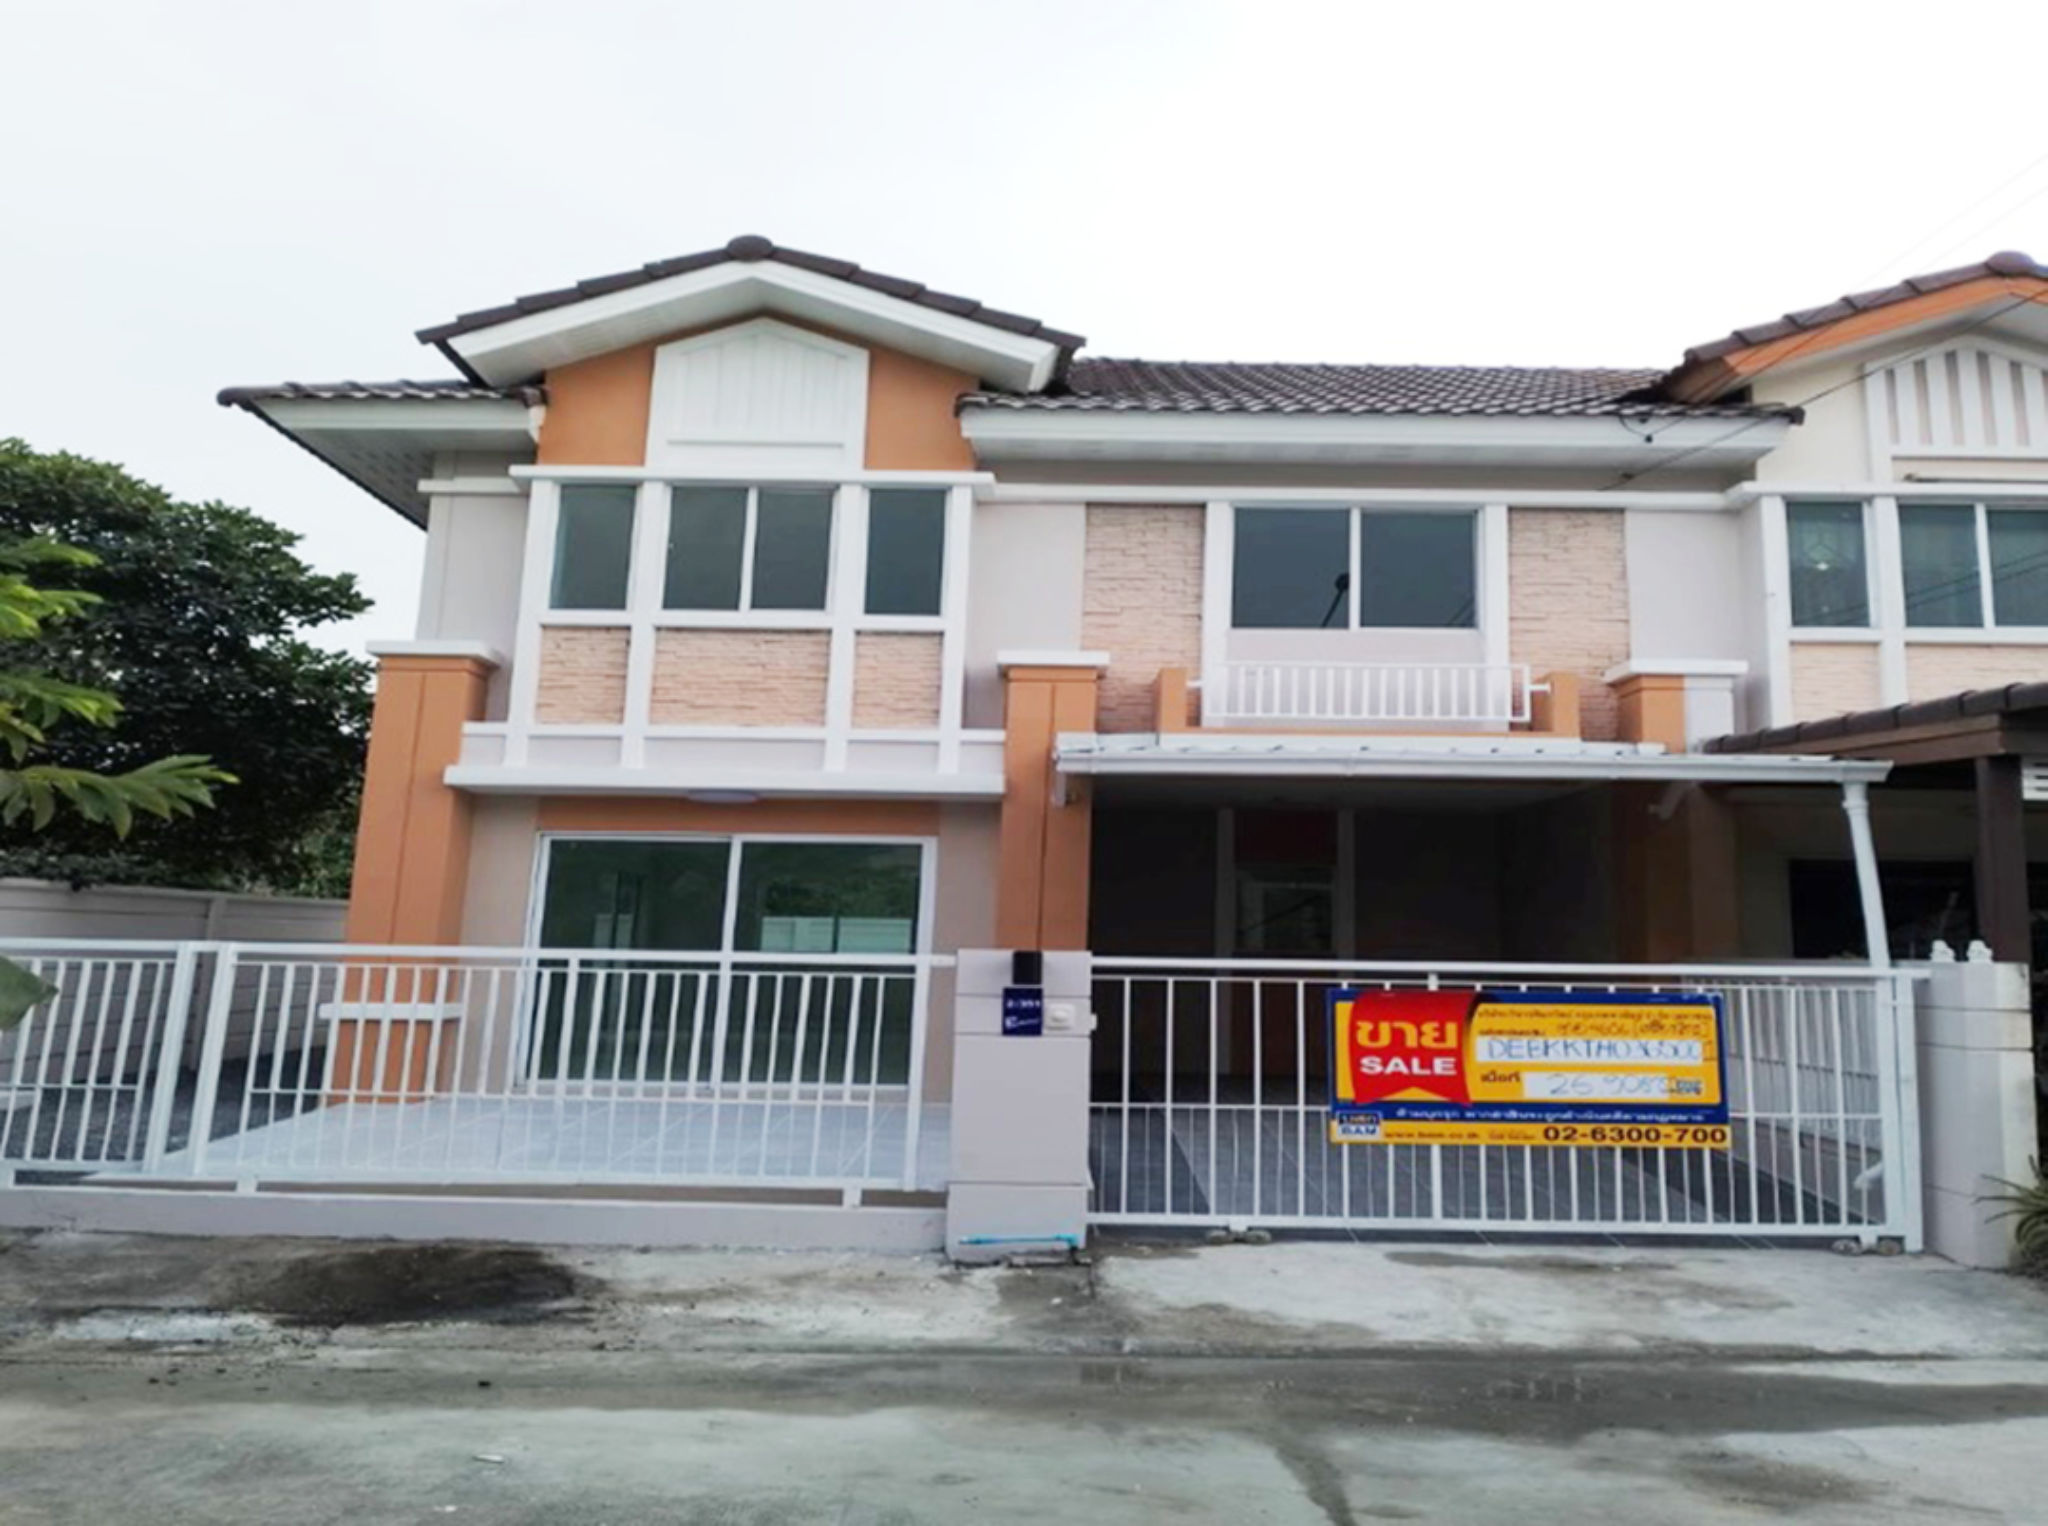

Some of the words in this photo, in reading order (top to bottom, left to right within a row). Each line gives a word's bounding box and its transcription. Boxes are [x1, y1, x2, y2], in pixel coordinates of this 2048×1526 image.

[1356, 1021, 1458, 1049] ขาย
[1360, 1055, 1457, 1075] SALE
[1542, 1125, 1728, 1144] 02-6300-700
